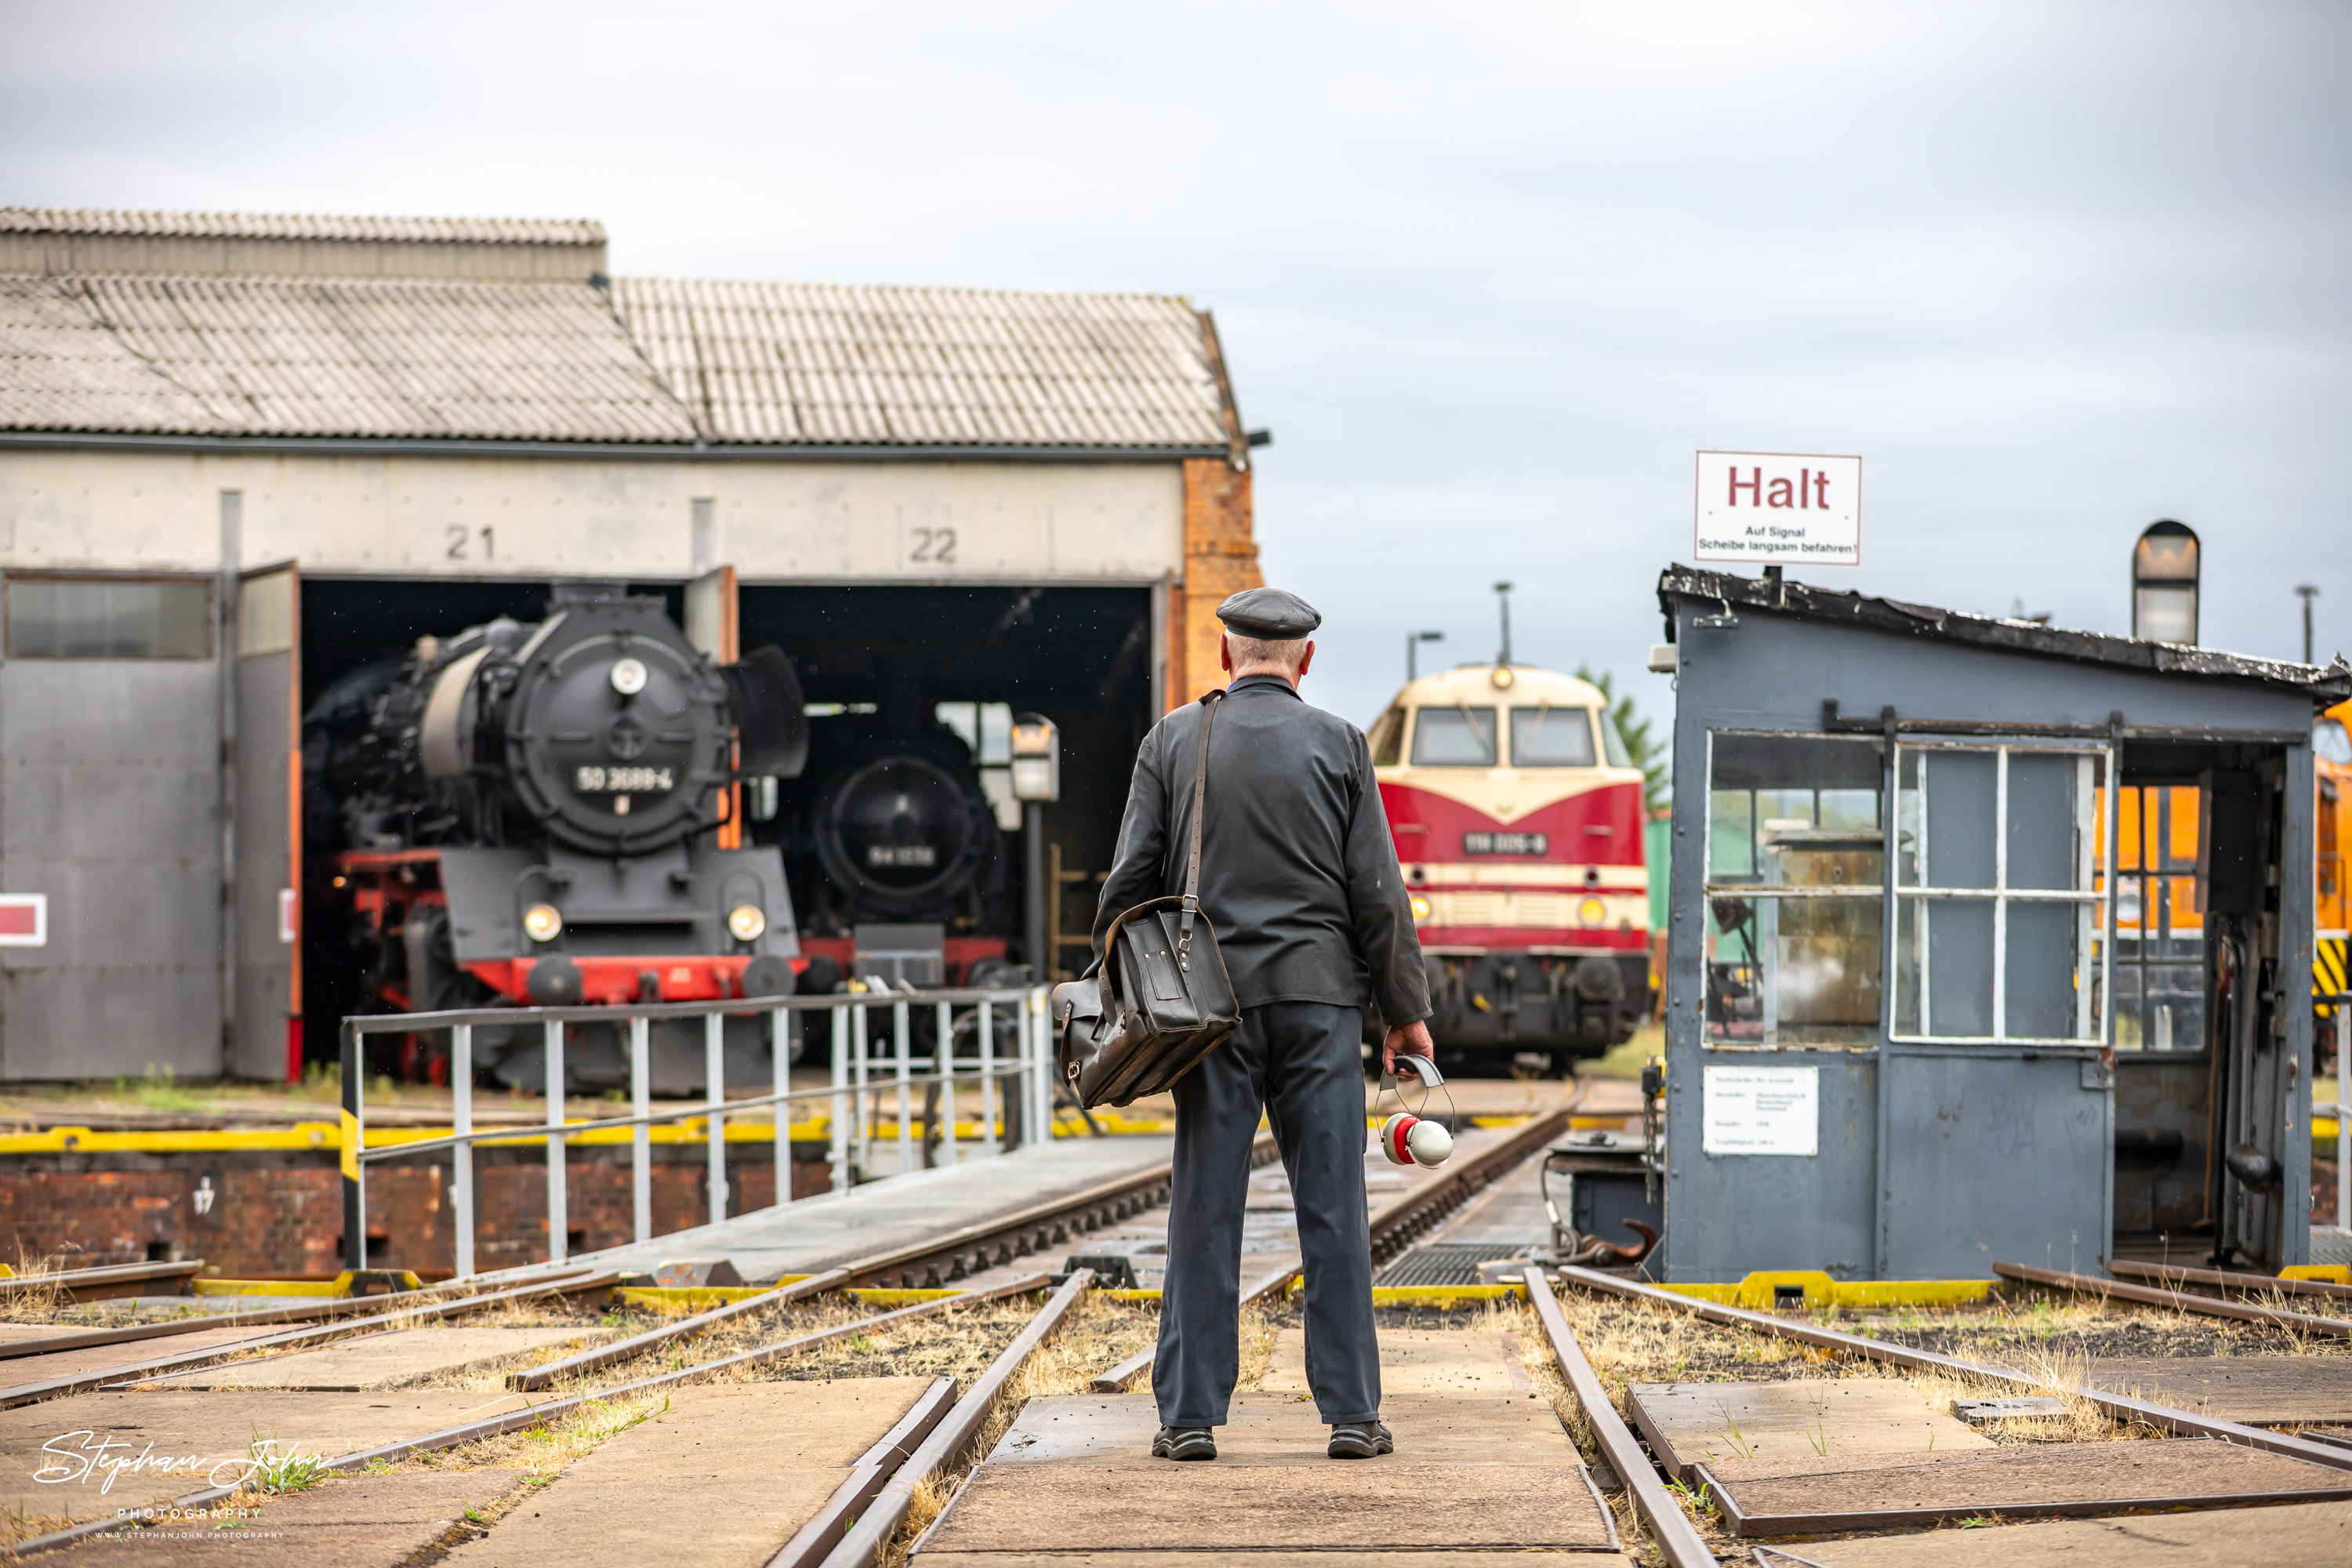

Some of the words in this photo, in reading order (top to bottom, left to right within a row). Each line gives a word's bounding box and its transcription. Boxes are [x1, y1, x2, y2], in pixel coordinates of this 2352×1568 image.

[1729, 466, 1830, 510] Halt
[445, 524, 494, 560] 21
[910, 528, 956, 564] 22
[1699, 539, 1745, 550] Scheibe
[1749, 541, 1797, 553] langsam
[1802, 543, 1857, 554] befahren!
[1745, 526, 1765, 536] Auf
[1769, 527, 1805, 539] Signal
[579, 768, 604, 790] 50
